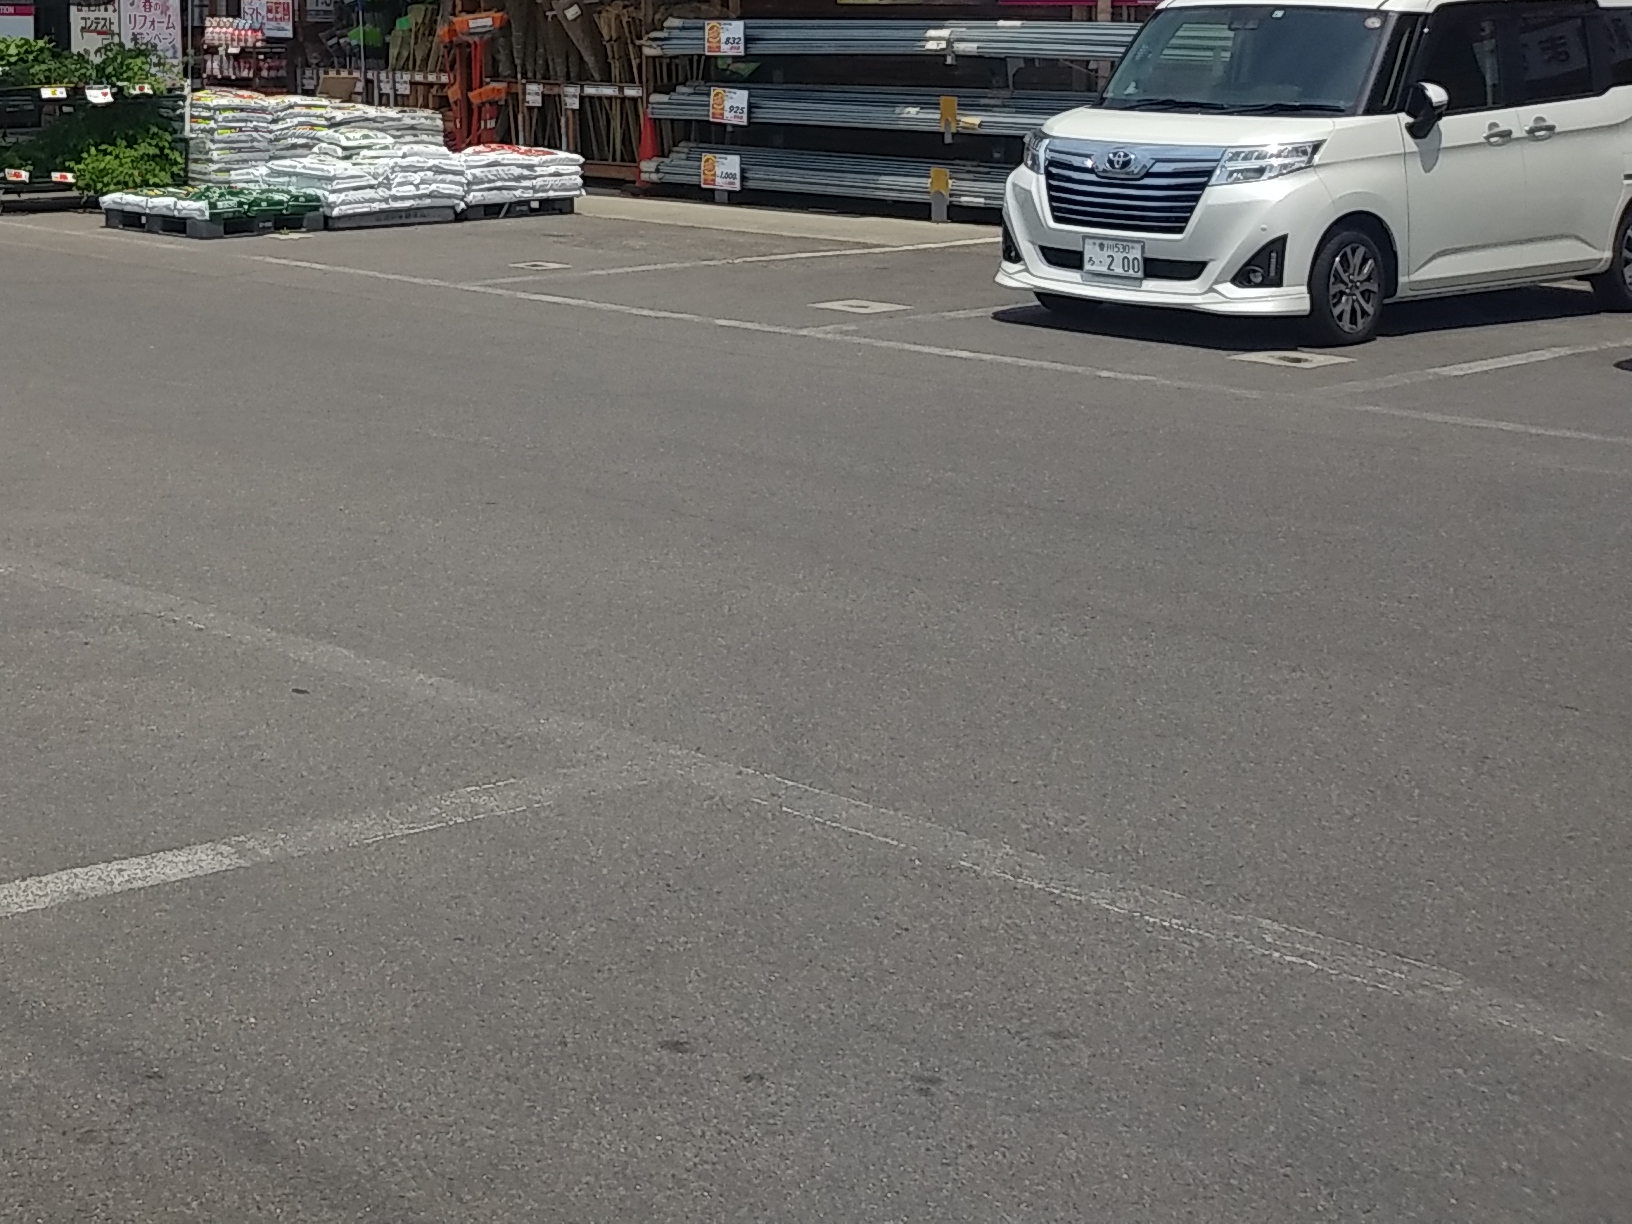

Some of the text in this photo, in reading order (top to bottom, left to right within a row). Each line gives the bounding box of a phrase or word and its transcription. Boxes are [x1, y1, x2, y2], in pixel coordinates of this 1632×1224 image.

[80, 16, 115, 31] コンテスト
[128, 13, 176, 32] リフォーム
